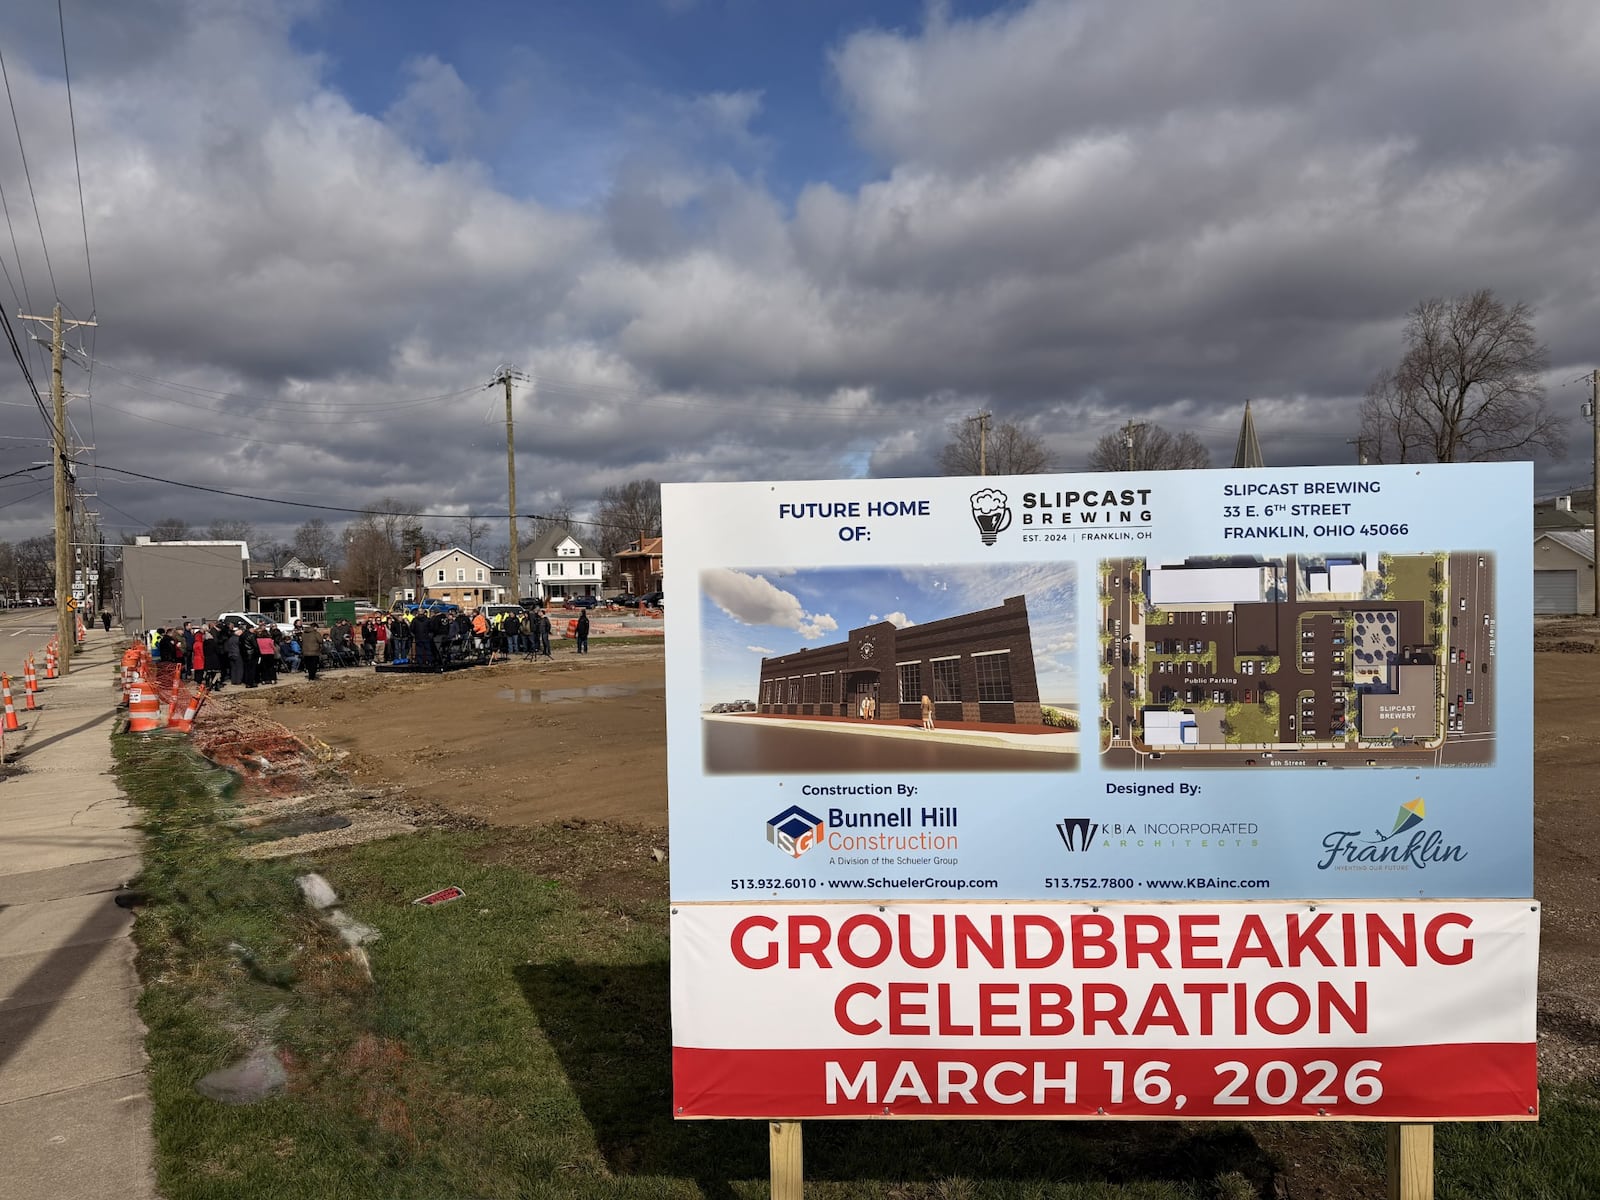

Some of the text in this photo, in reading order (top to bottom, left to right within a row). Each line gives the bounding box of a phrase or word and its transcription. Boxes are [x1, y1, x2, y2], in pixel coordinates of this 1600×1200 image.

[1224, 481, 1381, 496] SLIPCAST BREWING
[1022, 489, 1152, 509] SLIPCAST
[779, 501, 930, 519] FUTURE HOME
[1023, 510, 1152, 524] BREWING
[1223, 503, 1351, 517] 33 E. 6TH STREET
[838, 526, 871, 542] OF:
[1023, 532, 1152, 543] EST. 2024 FRANKLIN, OH
[1224, 523, 1409, 539] FRANKLIN, OHIO 45066
[1209, 677, 1238, 685] Parking
[801, 783, 918, 797] Construction By:
[1106, 783, 1201, 796] Designed By:
[828, 807, 958, 828] Bunnell Hill
[1144, 823, 1258, 834] INCORPORATED
[778, 830, 814, 859] SG
[828, 832, 958, 851] Construction
[1103, 839, 1259, 848] ARCHITECTS
[1317, 830, 1468, 870] Franklin
[829, 856, 959, 867] A Division of the Schueler Group
[730, 877, 998, 891] 513.932.6010 www.SchuelerGroup.com
[1045, 877, 1270, 889] 513.752.7800 www.KBAinc.com
[730, 913, 1475, 970] GROUNDBREAKING
[834, 981, 1369, 1037] CELEBRATION
[824, 1060, 1385, 1111] MARCH 16, 2026
